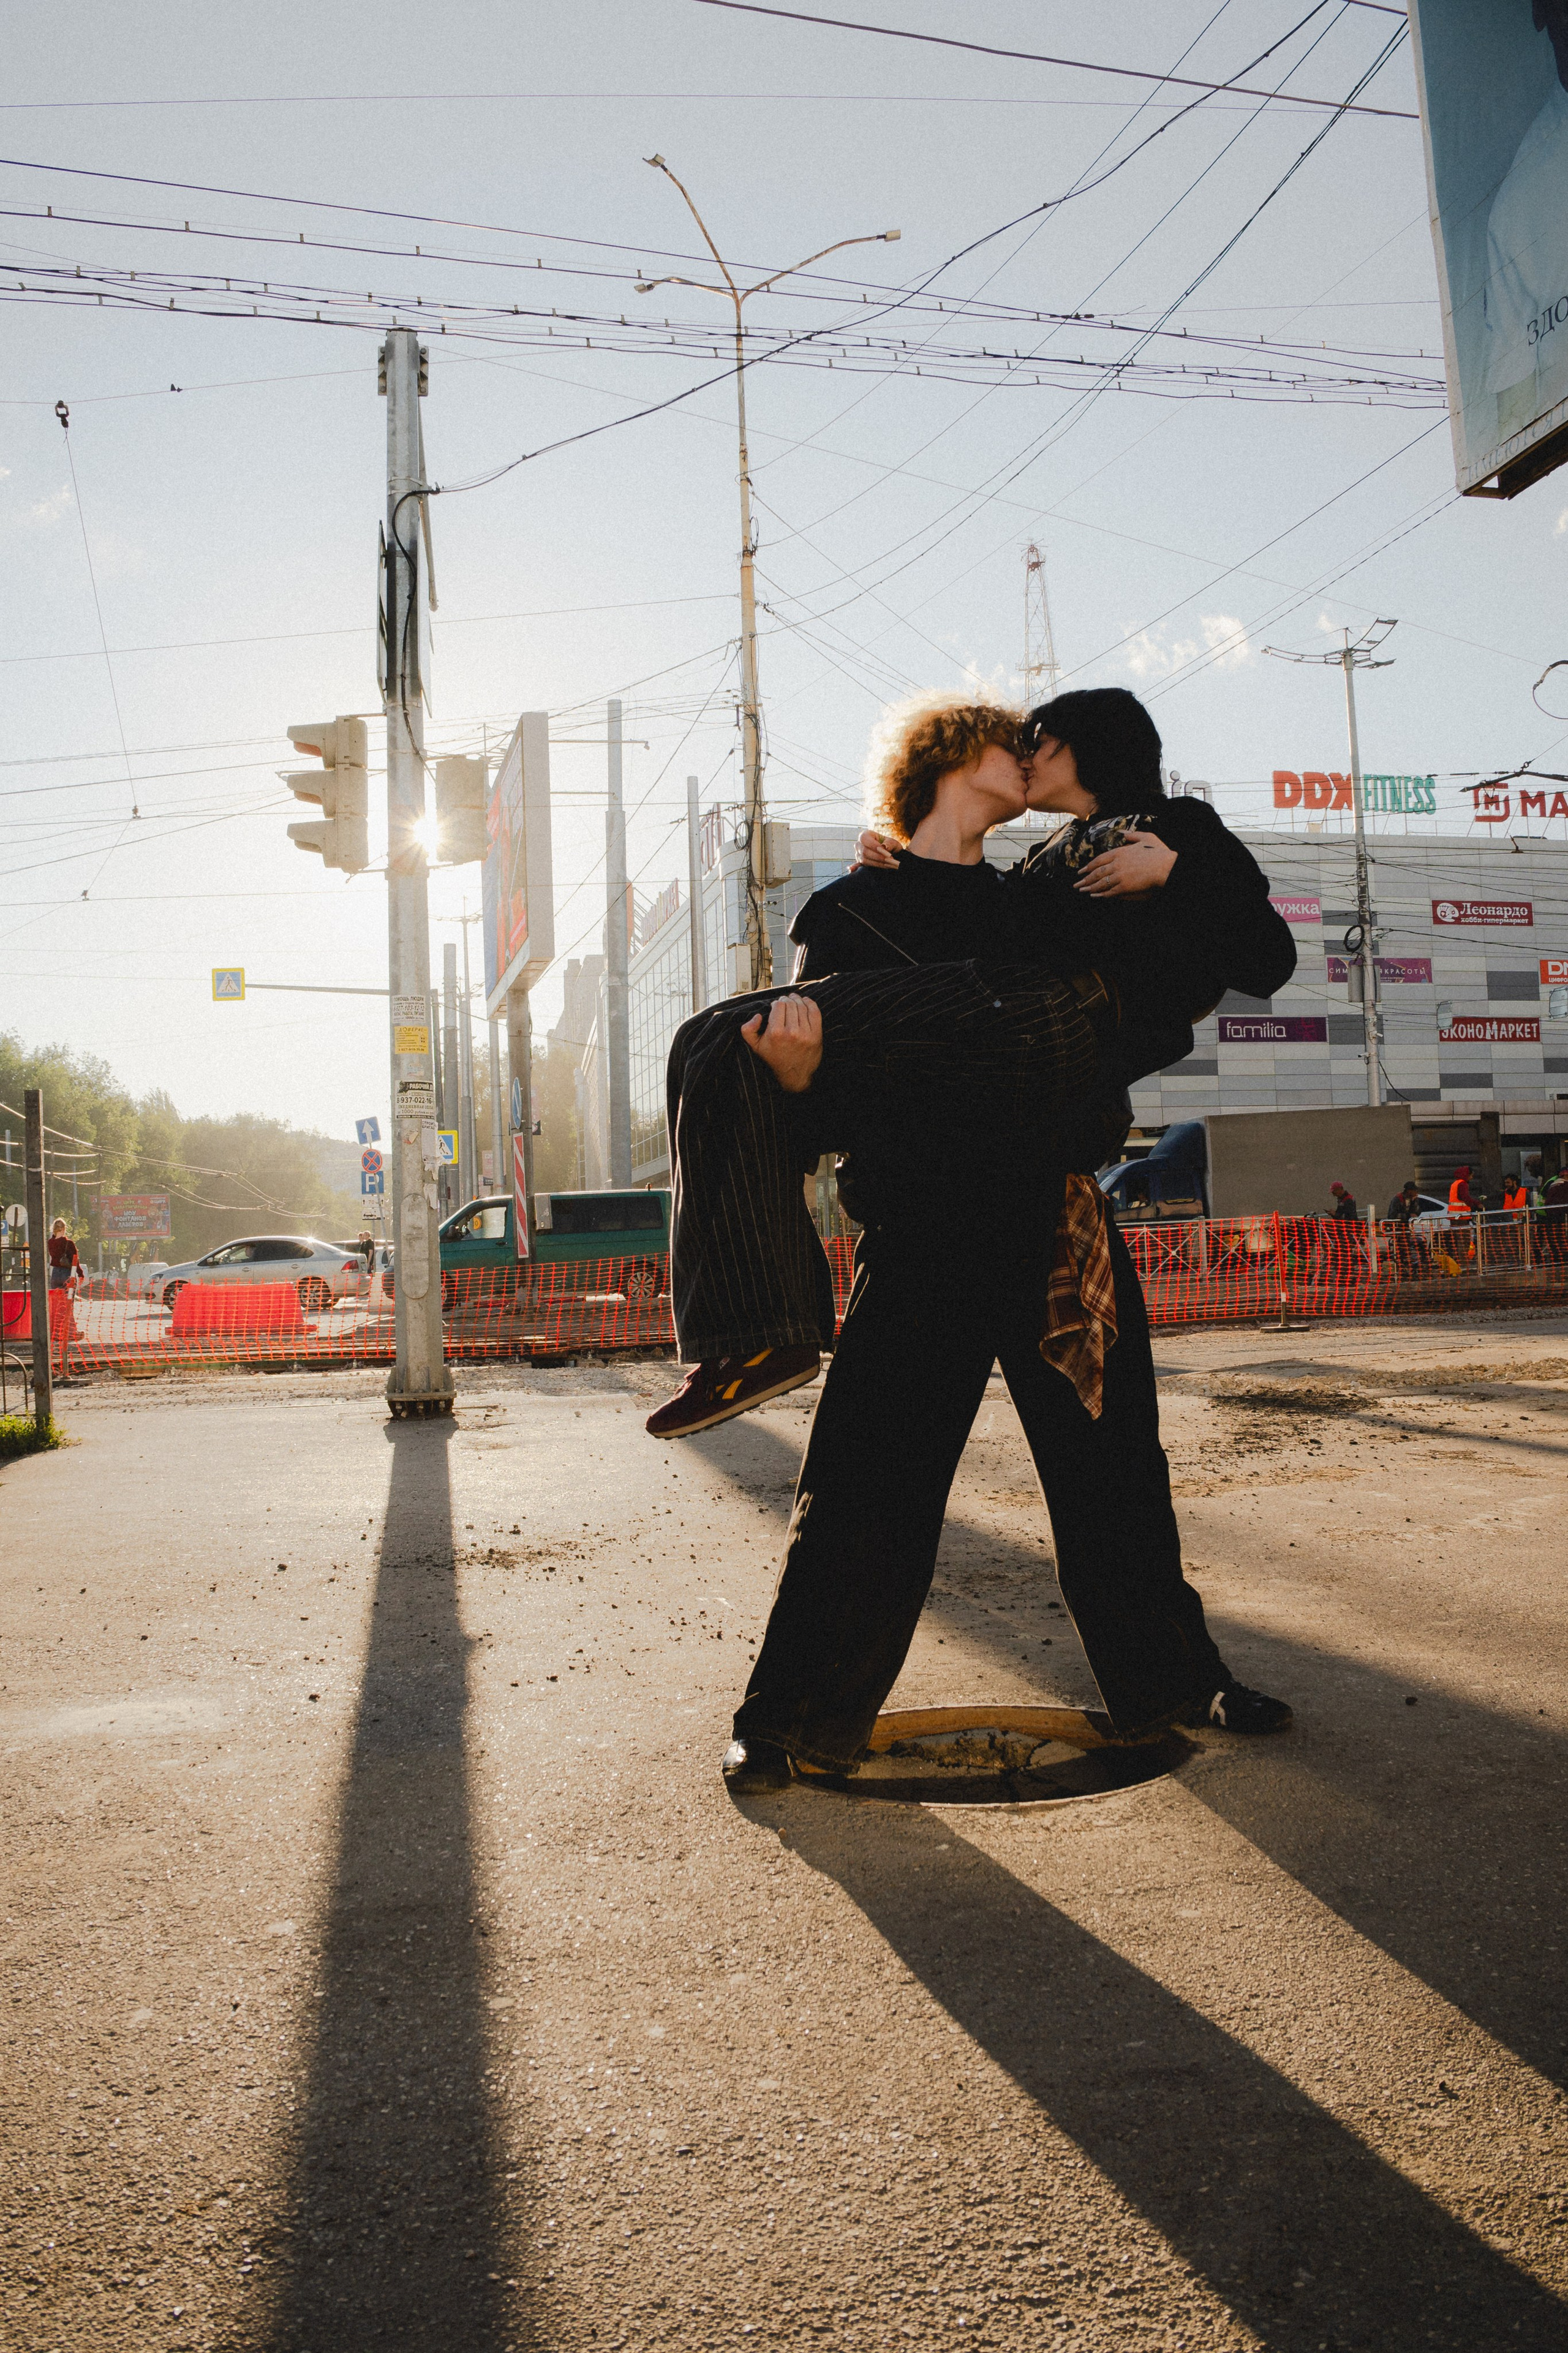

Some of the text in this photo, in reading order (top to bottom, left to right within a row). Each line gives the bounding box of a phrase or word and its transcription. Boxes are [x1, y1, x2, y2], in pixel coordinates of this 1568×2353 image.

[1273, 771, 1436, 815] DDX FITNESS
[1460, 902, 1528, 918] Леонардо
[1461, 916, 1529, 925] хобби-гипермаркет
[1227, 1022, 1286, 1038] familia
